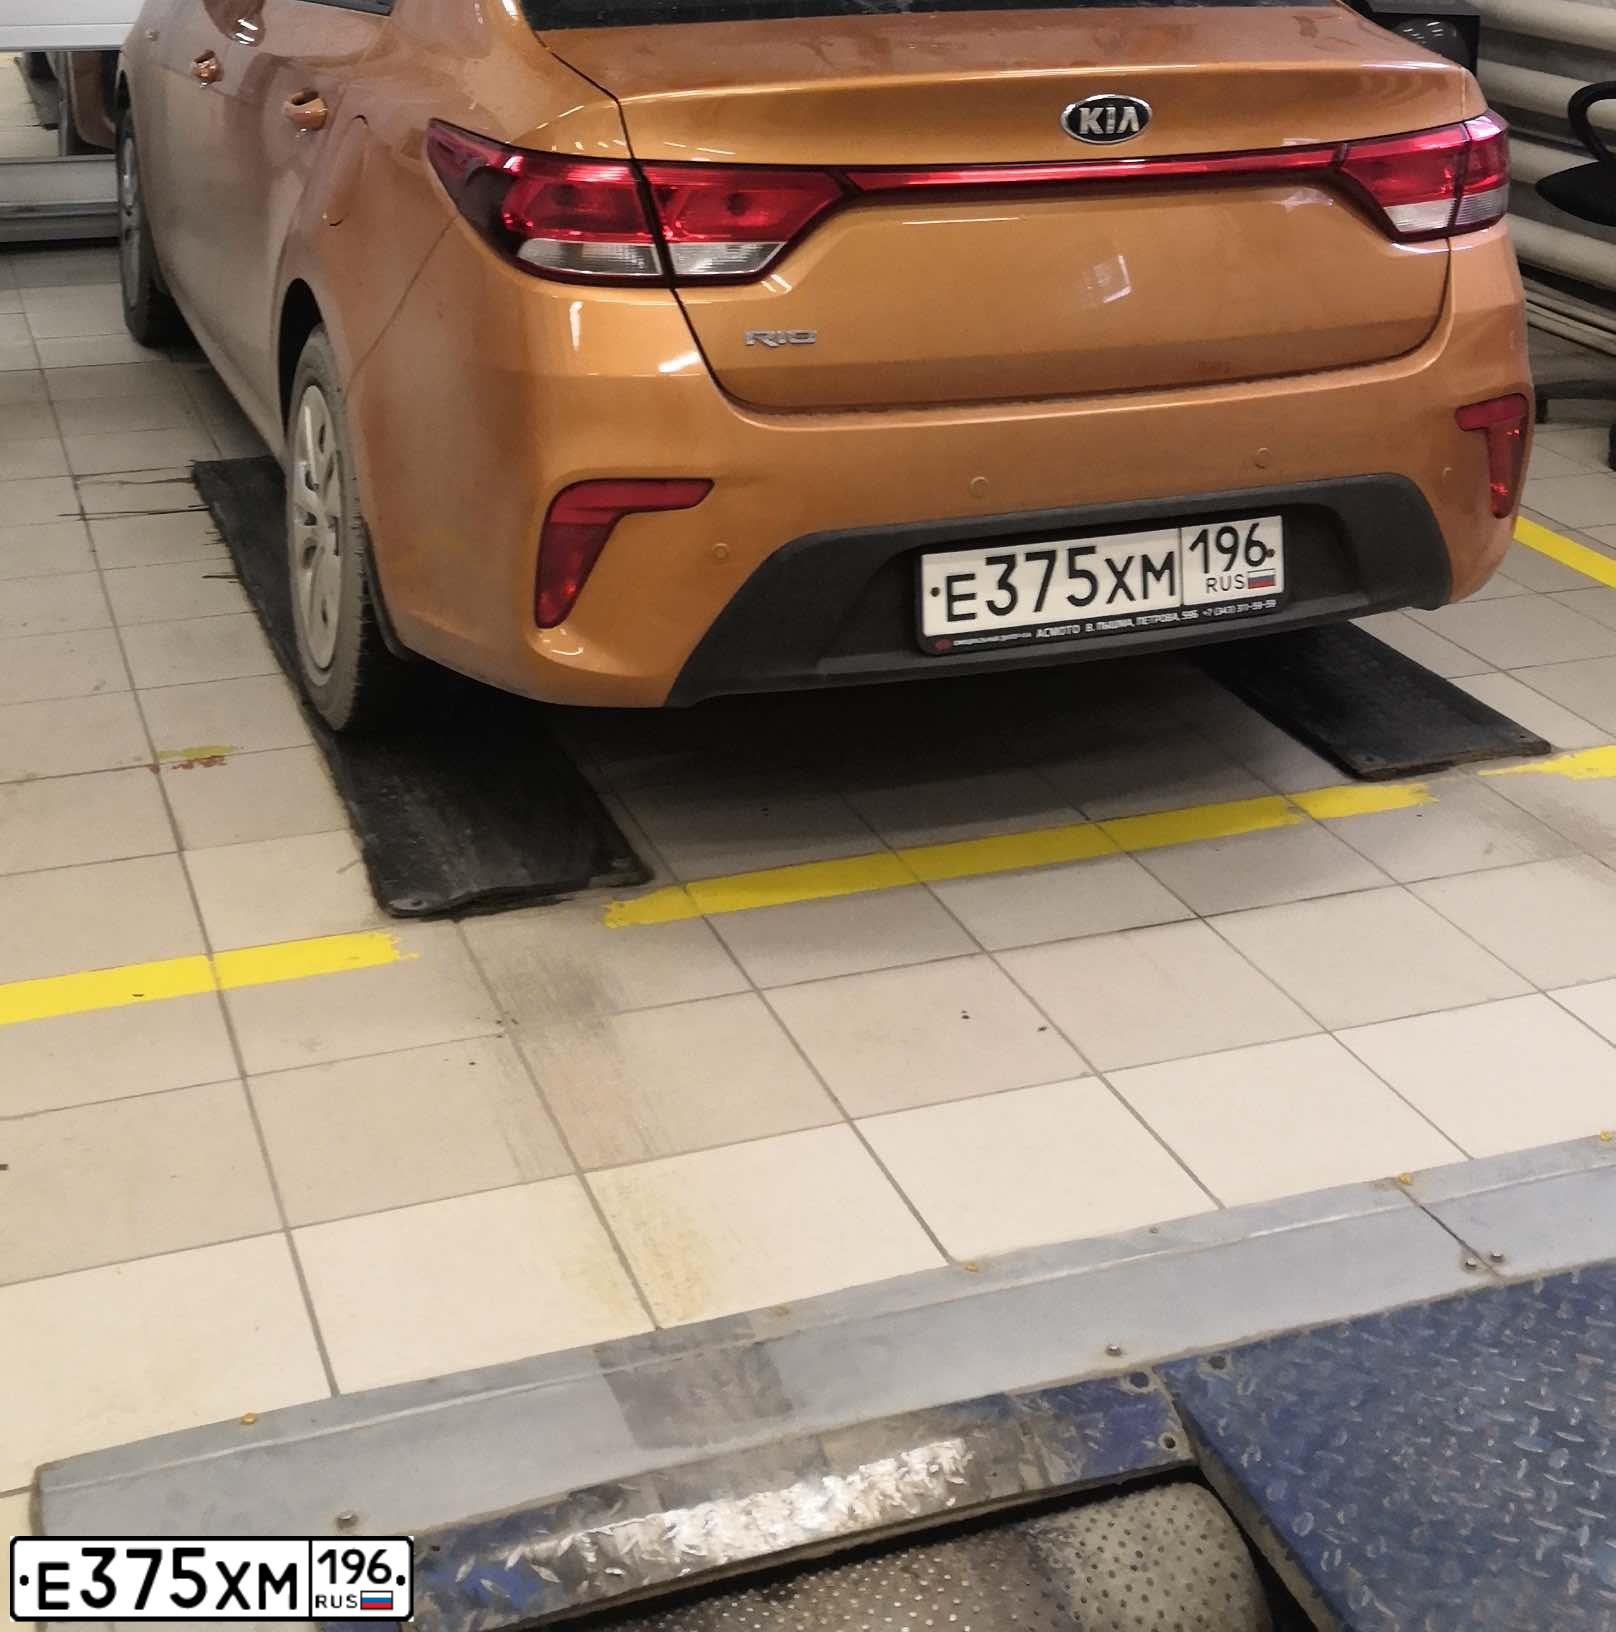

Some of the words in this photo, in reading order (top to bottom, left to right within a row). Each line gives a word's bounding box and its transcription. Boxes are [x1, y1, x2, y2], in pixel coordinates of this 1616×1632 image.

[1078, 106, 1140, 134] KIA
[1188, 522, 1268, 574] 196
[1205, 573, 1246, 594] RUS
